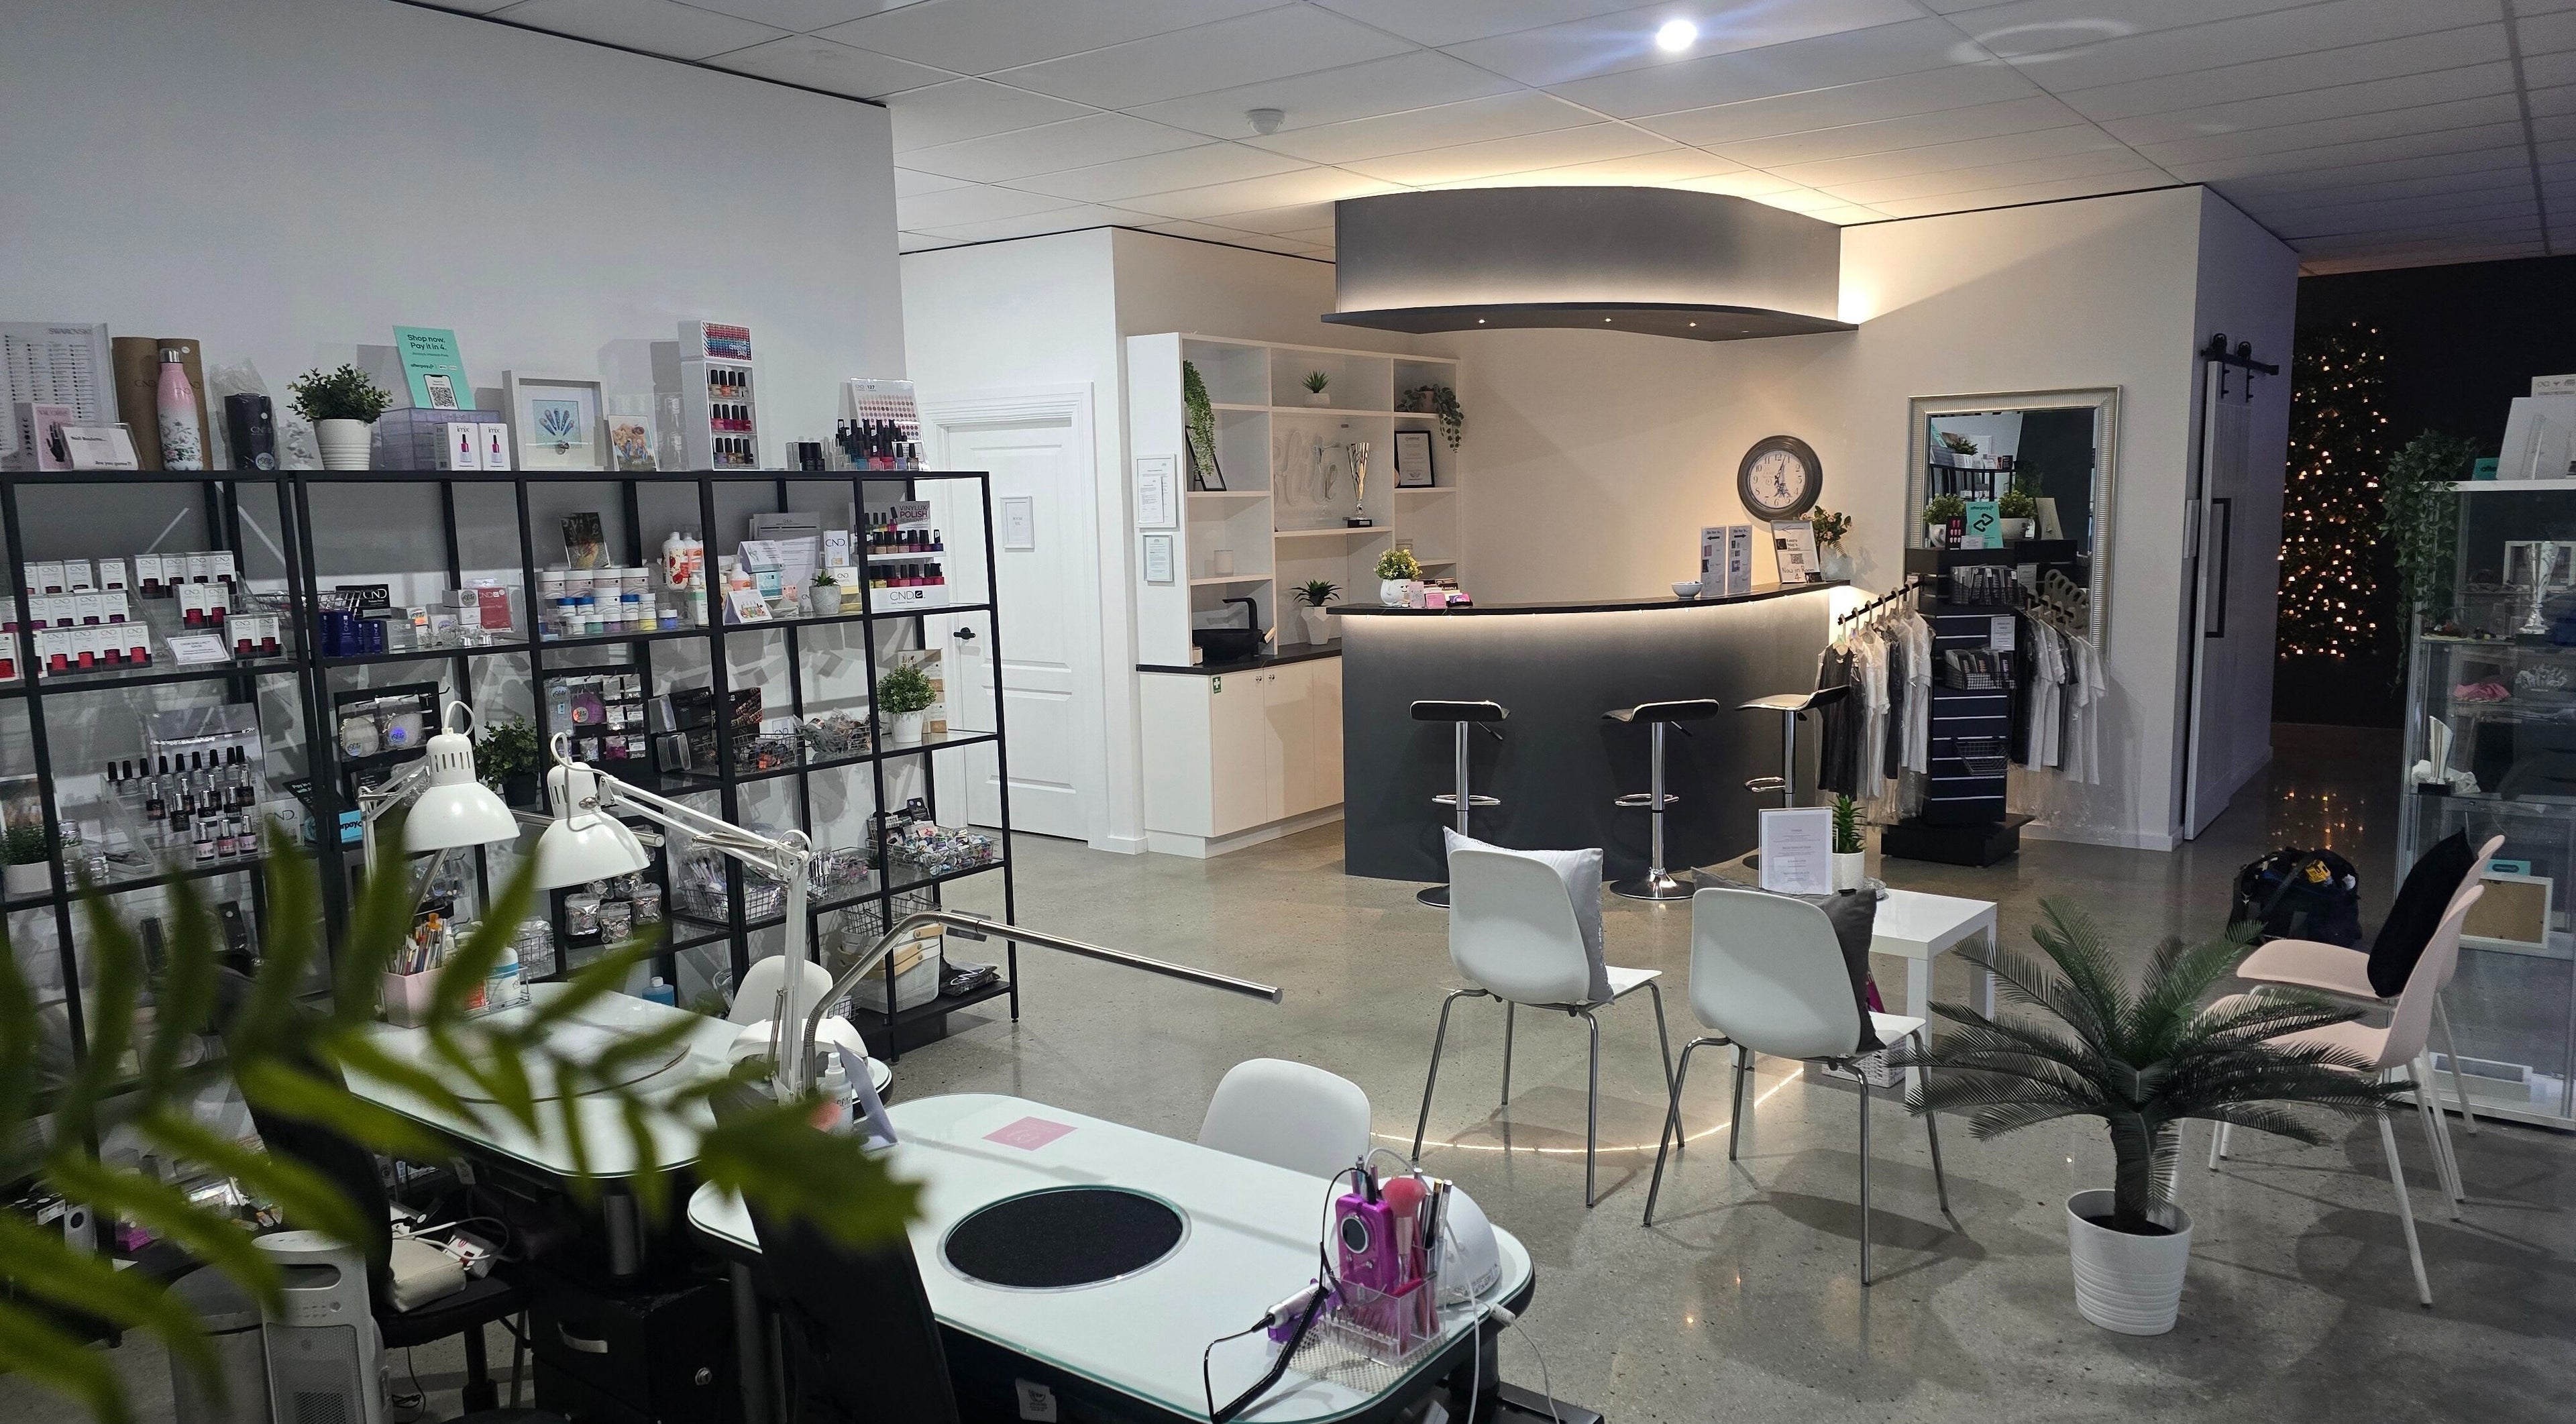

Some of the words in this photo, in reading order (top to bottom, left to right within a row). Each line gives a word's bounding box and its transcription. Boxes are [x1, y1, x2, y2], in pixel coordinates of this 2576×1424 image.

[407, 335, 427, 343] Shop
[411, 343, 425, 351] Pay
[1774, 453, 1782, 461] 12
[1756, 463, 1762, 473] 10
[1795, 463, 1801, 472] 2
[1753, 476, 1758, 484] 9
[1755, 488, 1760, 496] 8
[1774, 498, 1779, 507] 6
[825, 539, 846, 547] CND
[1794, 573, 1802, 581] 4
[363, 588, 388, 599] CND
[890, 591, 914, 601] CND
